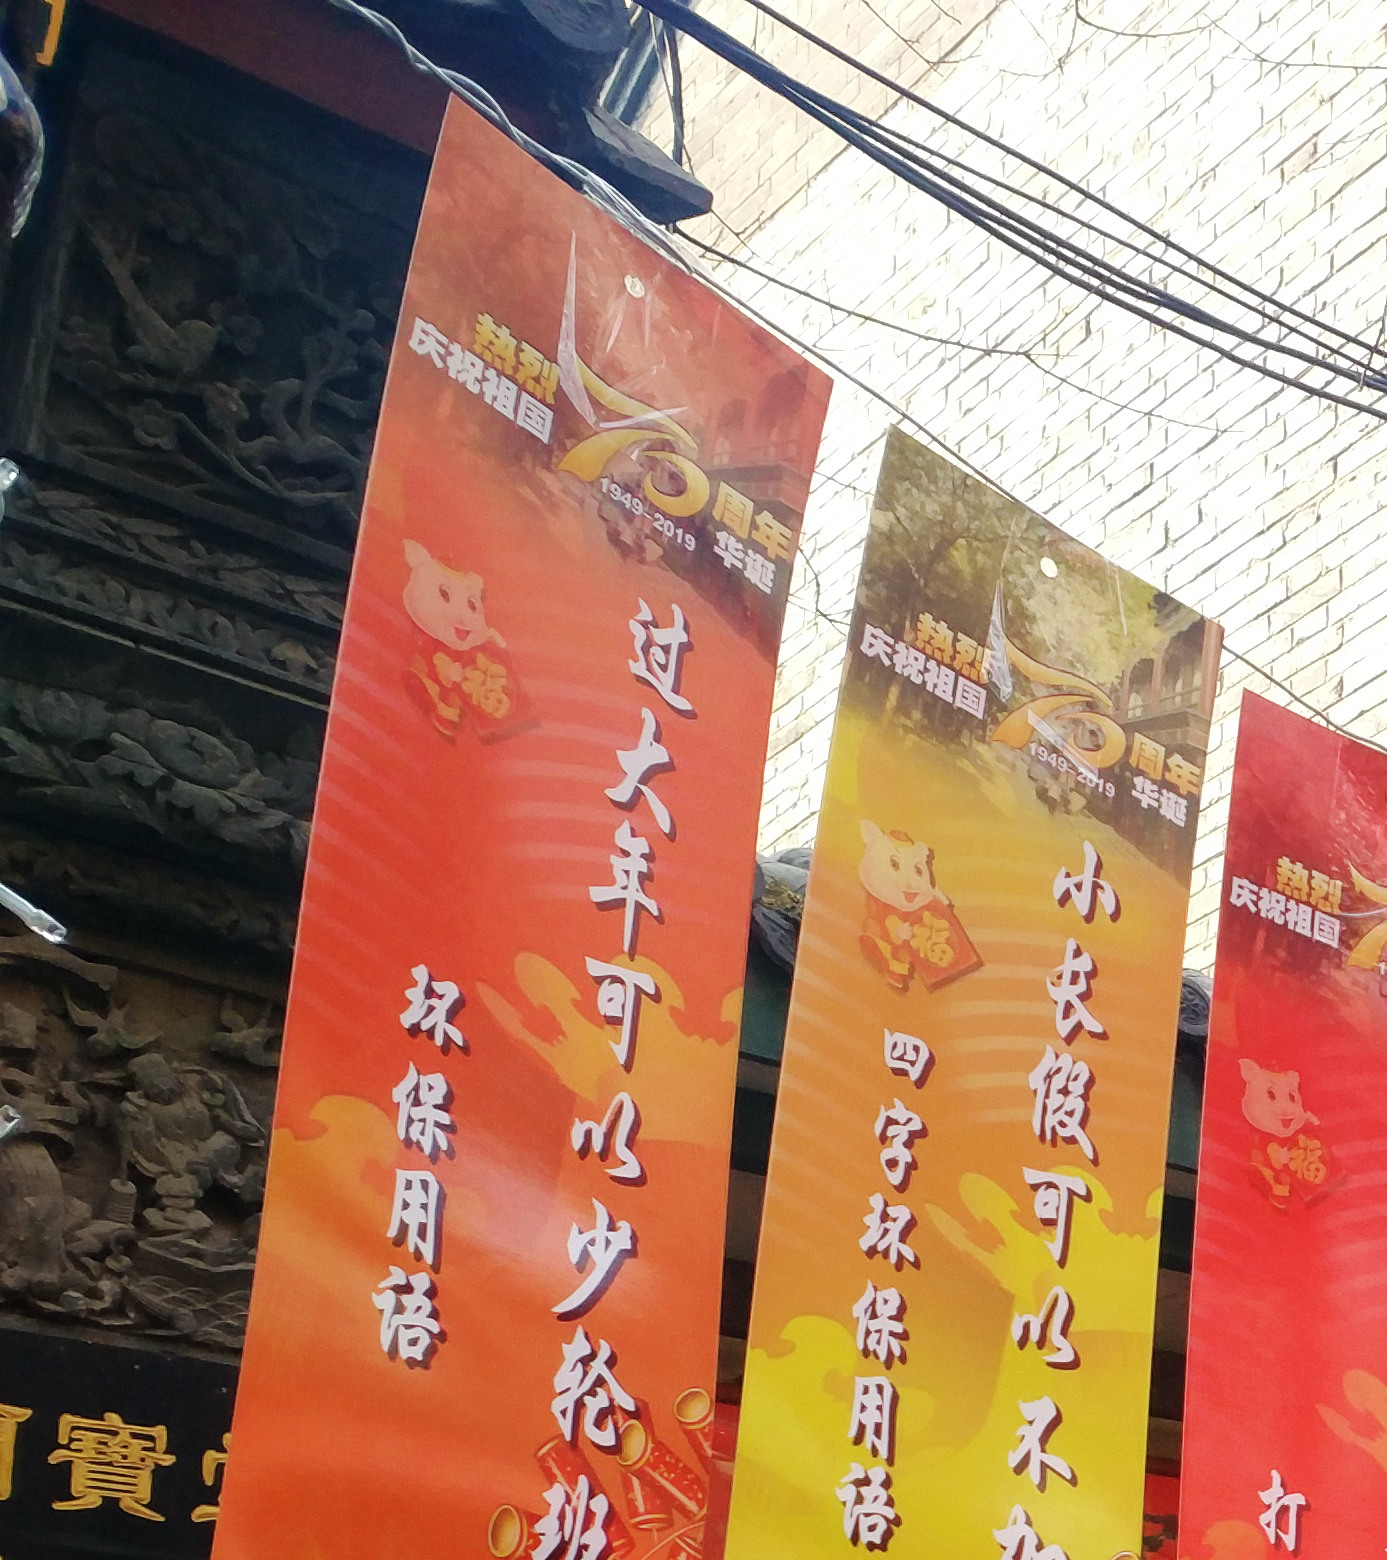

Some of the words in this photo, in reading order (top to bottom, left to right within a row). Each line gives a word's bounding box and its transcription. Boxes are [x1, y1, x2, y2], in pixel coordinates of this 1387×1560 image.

[409, 317, 554, 444] 庆祝祖国
[600, 476, 696, 551] 1949-2019
[712, 481, 792, 562] 周年
[712, 531, 776, 595] 华诞
[860, 623, 987, 719] 庆祝祖国
[1129, 731, 1200, 795] 周年
[1131, 775, 1188, 828] 华诞
[1230, 876, 1341, 948] 庆祝祖国
[373, 965, 465, 1367] 环保用语
[837, 1027, 934, 1550] 四字环保用语
